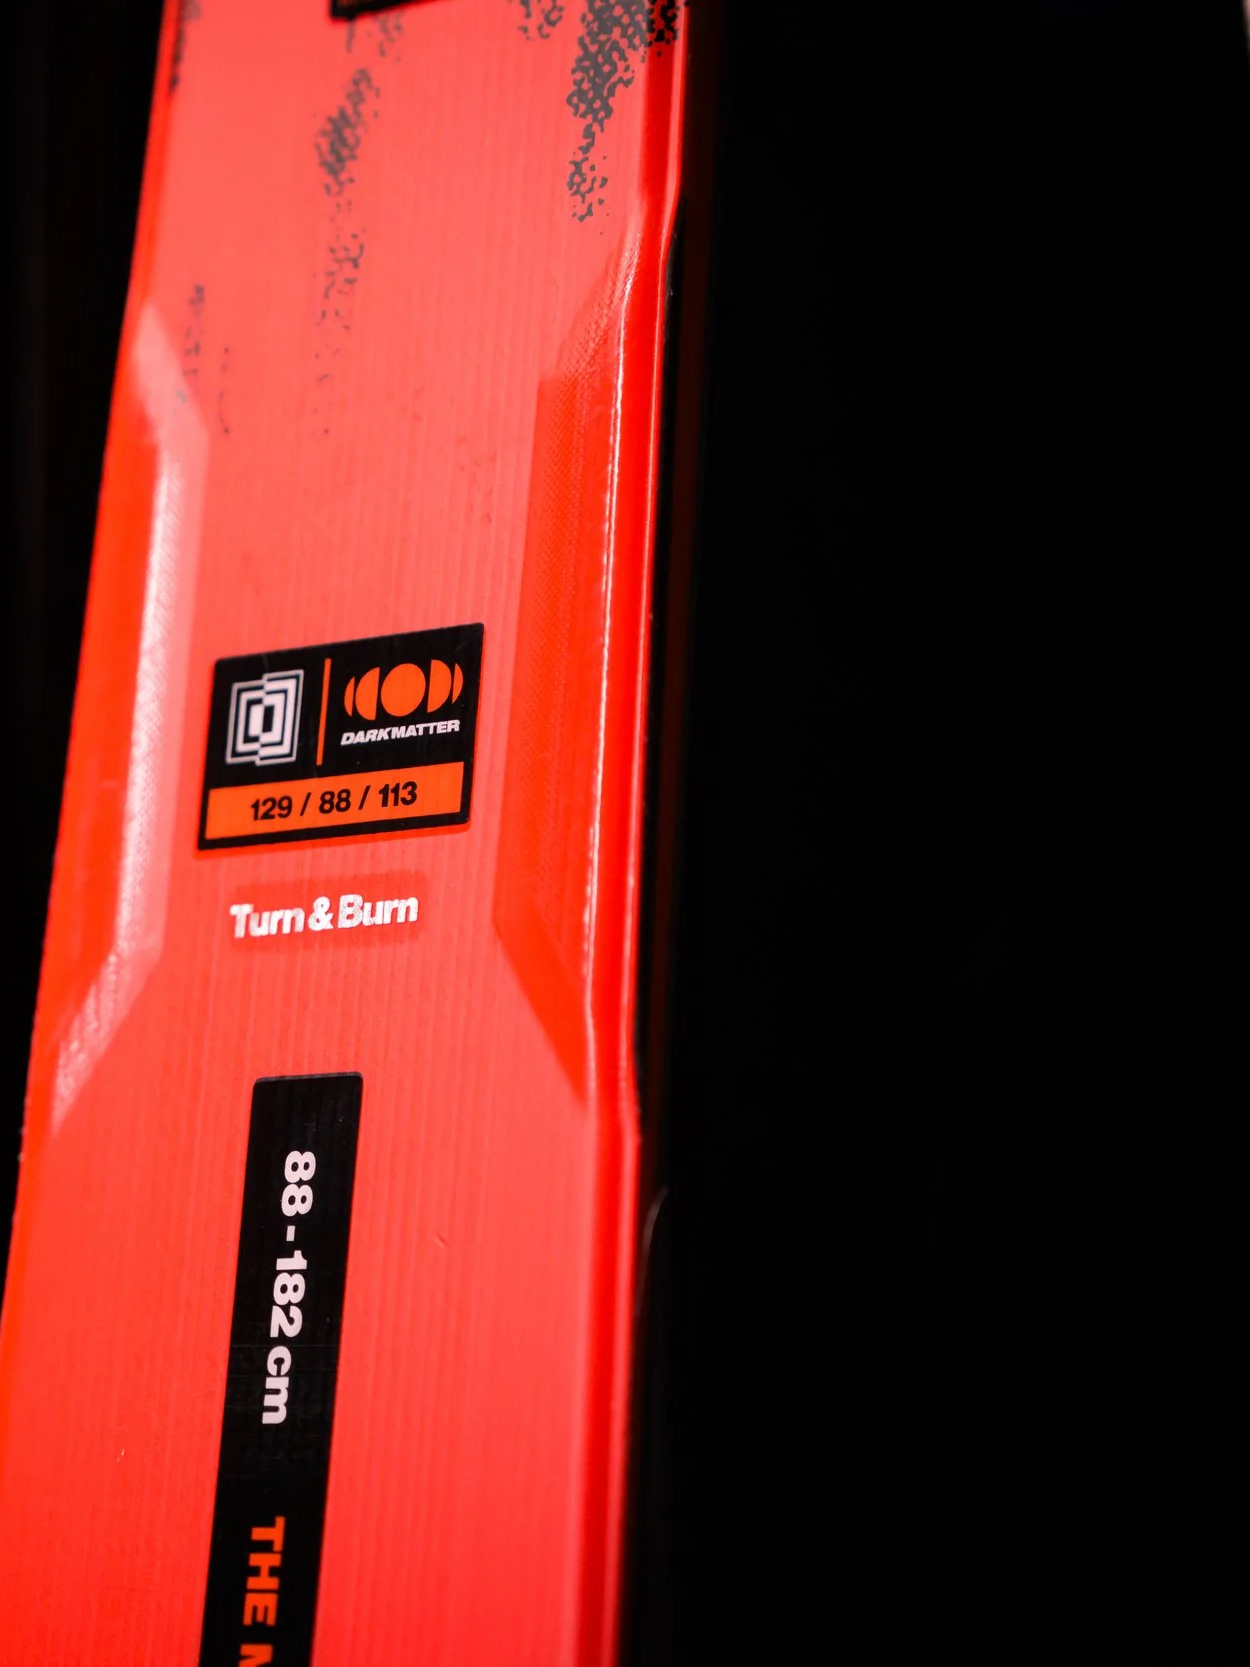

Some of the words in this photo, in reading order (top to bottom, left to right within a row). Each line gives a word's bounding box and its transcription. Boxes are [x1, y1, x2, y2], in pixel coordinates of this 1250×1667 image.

[340, 719, 461, 746] DARKMATTER
[251, 795, 293, 821] 129
[299, 792, 312, 817] /
[318, 788, 351, 815] 88
[358, 785, 371, 810] /
[378, 781, 418, 808] 113
[229, 903, 306, 938] Turn
[307, 896, 334, 932] &
[337, 894, 419, 930] Burn
[281, 1150, 317, 1217] 88
[269, 1249, 308, 1338] 182
[261, 1345, 292, 1425] cm
[243, 1516, 286, 1626] THE
